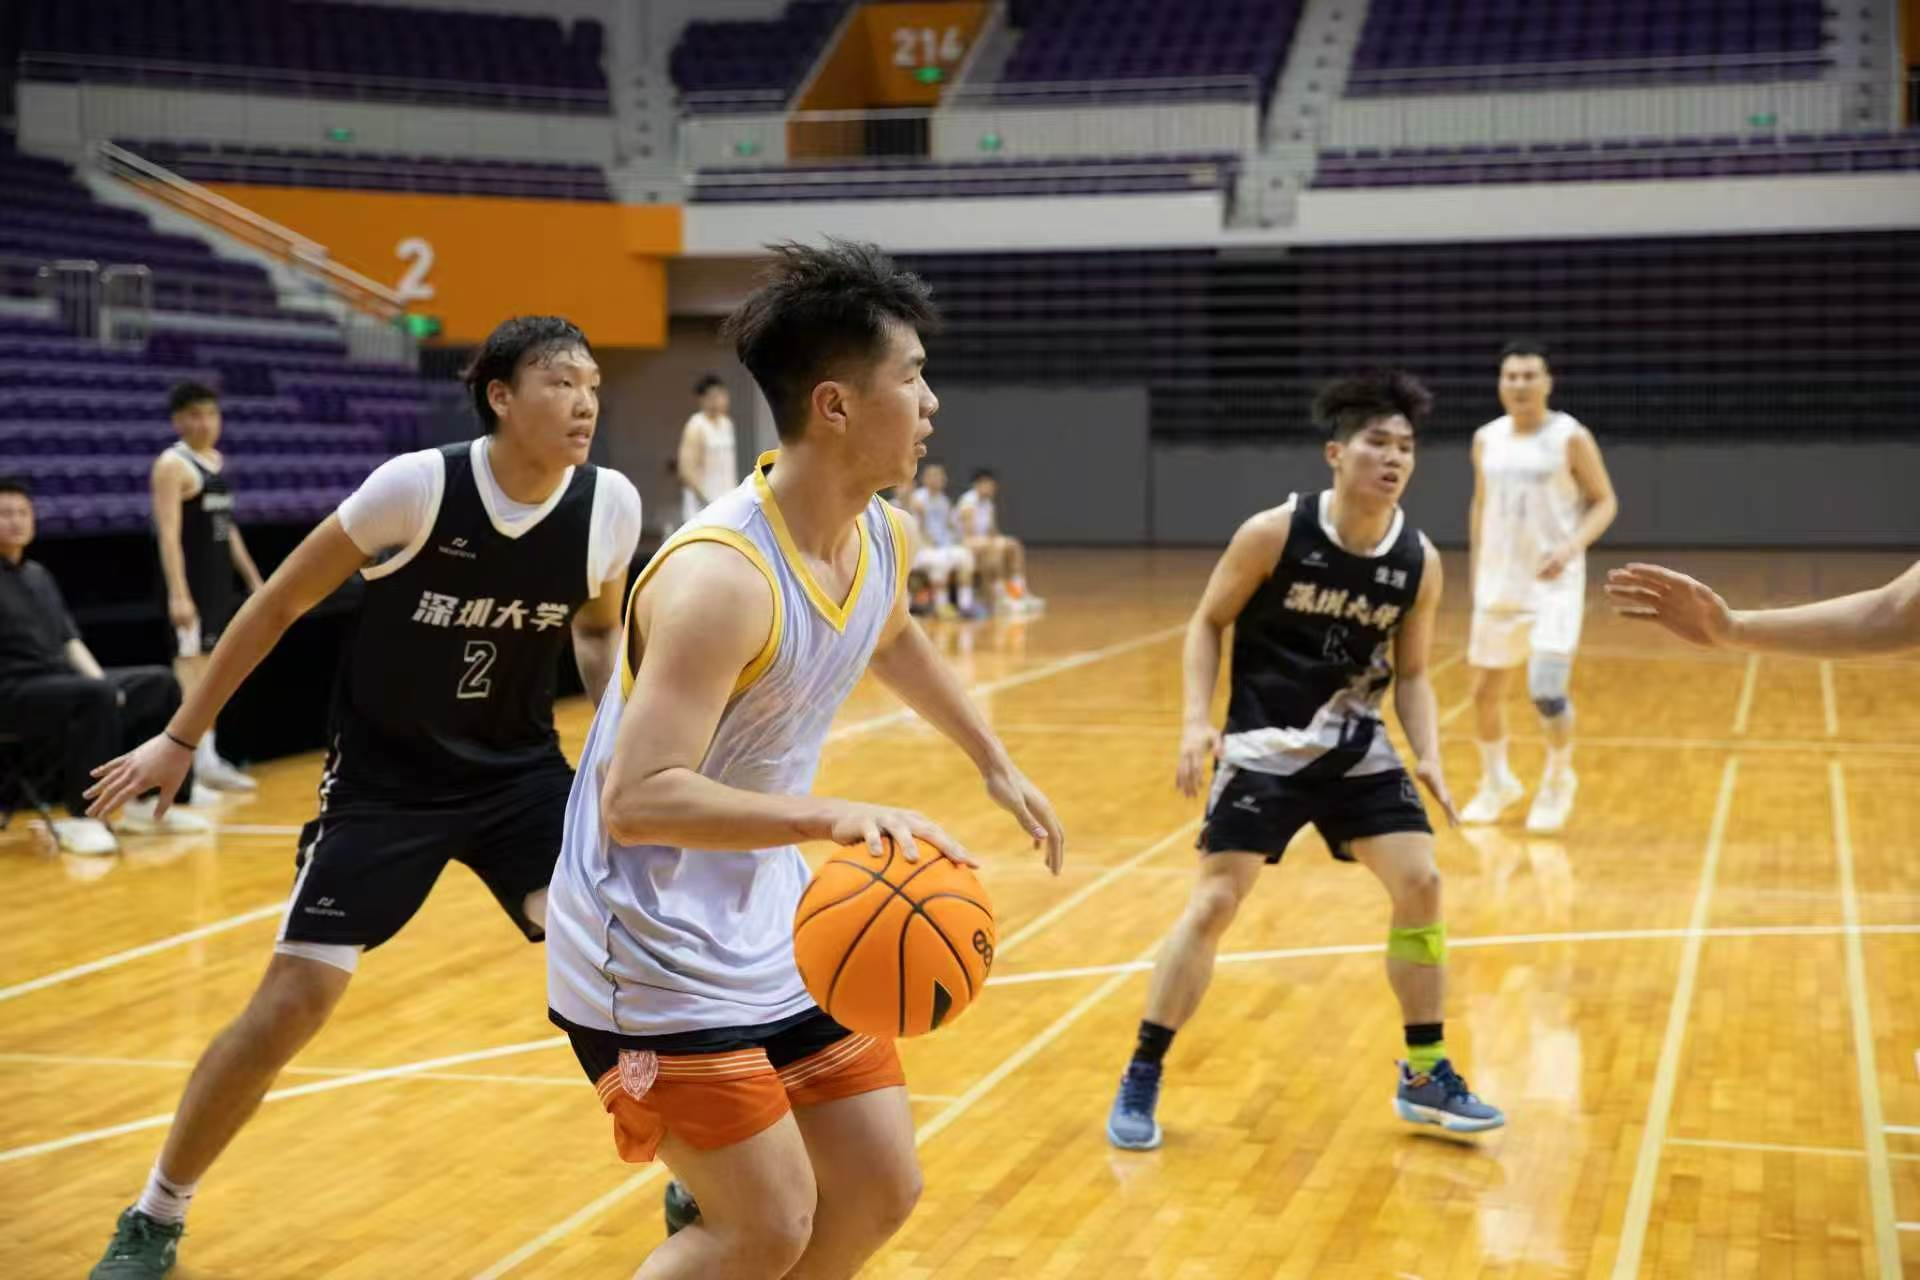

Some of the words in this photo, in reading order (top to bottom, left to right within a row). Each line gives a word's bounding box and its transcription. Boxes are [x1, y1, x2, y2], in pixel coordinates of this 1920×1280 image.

[891, 27, 963, 66] 214
[395, 237, 435, 301] 2
[412, 590, 569, 632] 深圳大学
[456, 640, 498, 700] 2
